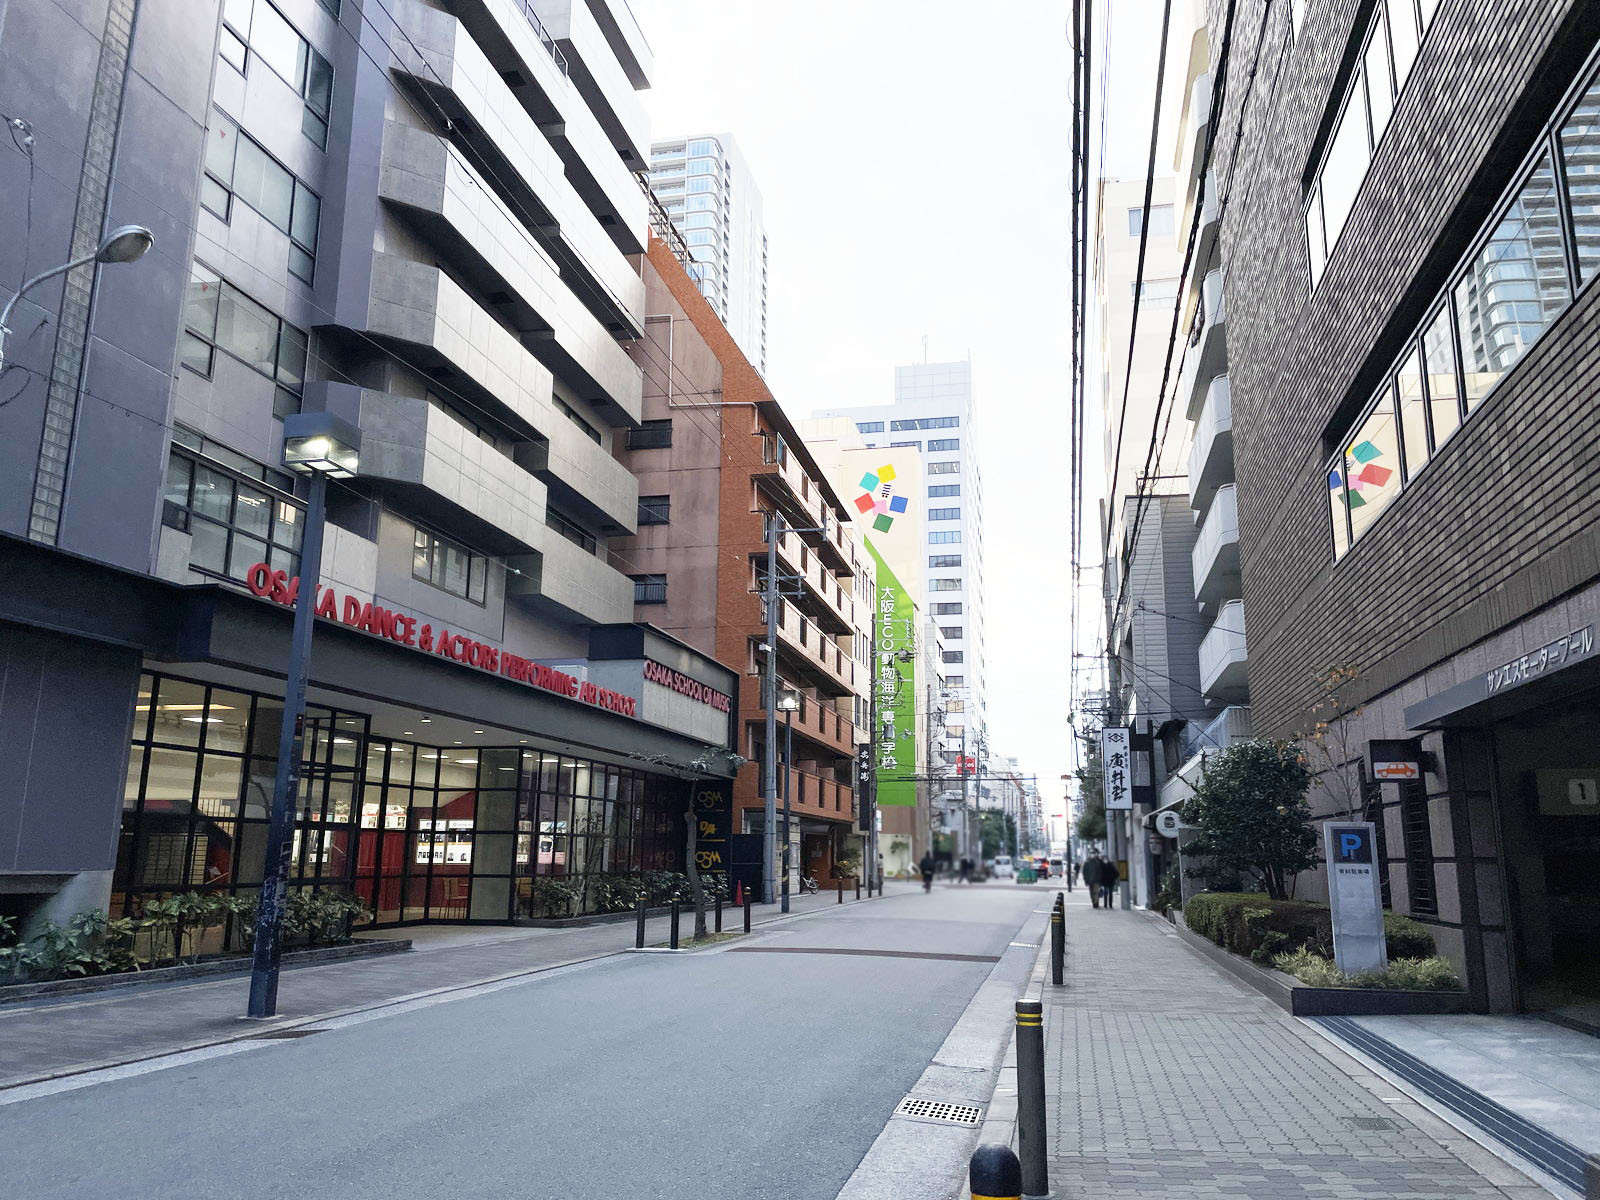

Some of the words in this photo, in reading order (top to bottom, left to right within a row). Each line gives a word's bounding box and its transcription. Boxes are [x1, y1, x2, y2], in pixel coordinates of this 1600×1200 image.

[247, 562, 337, 621] OSAA
[343, 595, 416, 646] DANCE
[419, 624, 433, 651] &
[436, 630, 498, 672] ACTORS
[501, 651, 578, 697] PERFORMING
[599, 688, 636, 717] SCHOOL
[1487, 628, 1592, 692] サンエスモータープール
[643, 660, 672, 688] OSAKA
[673, 672, 702, 701] SCHOOL
[703, 687, 713, 704] OF
[713, 690, 731, 713] MUSIC
[1578, 782, 1586, 800] 1
[695, 851, 722, 869] OSM
[1340, 833, 1362, 857] P
